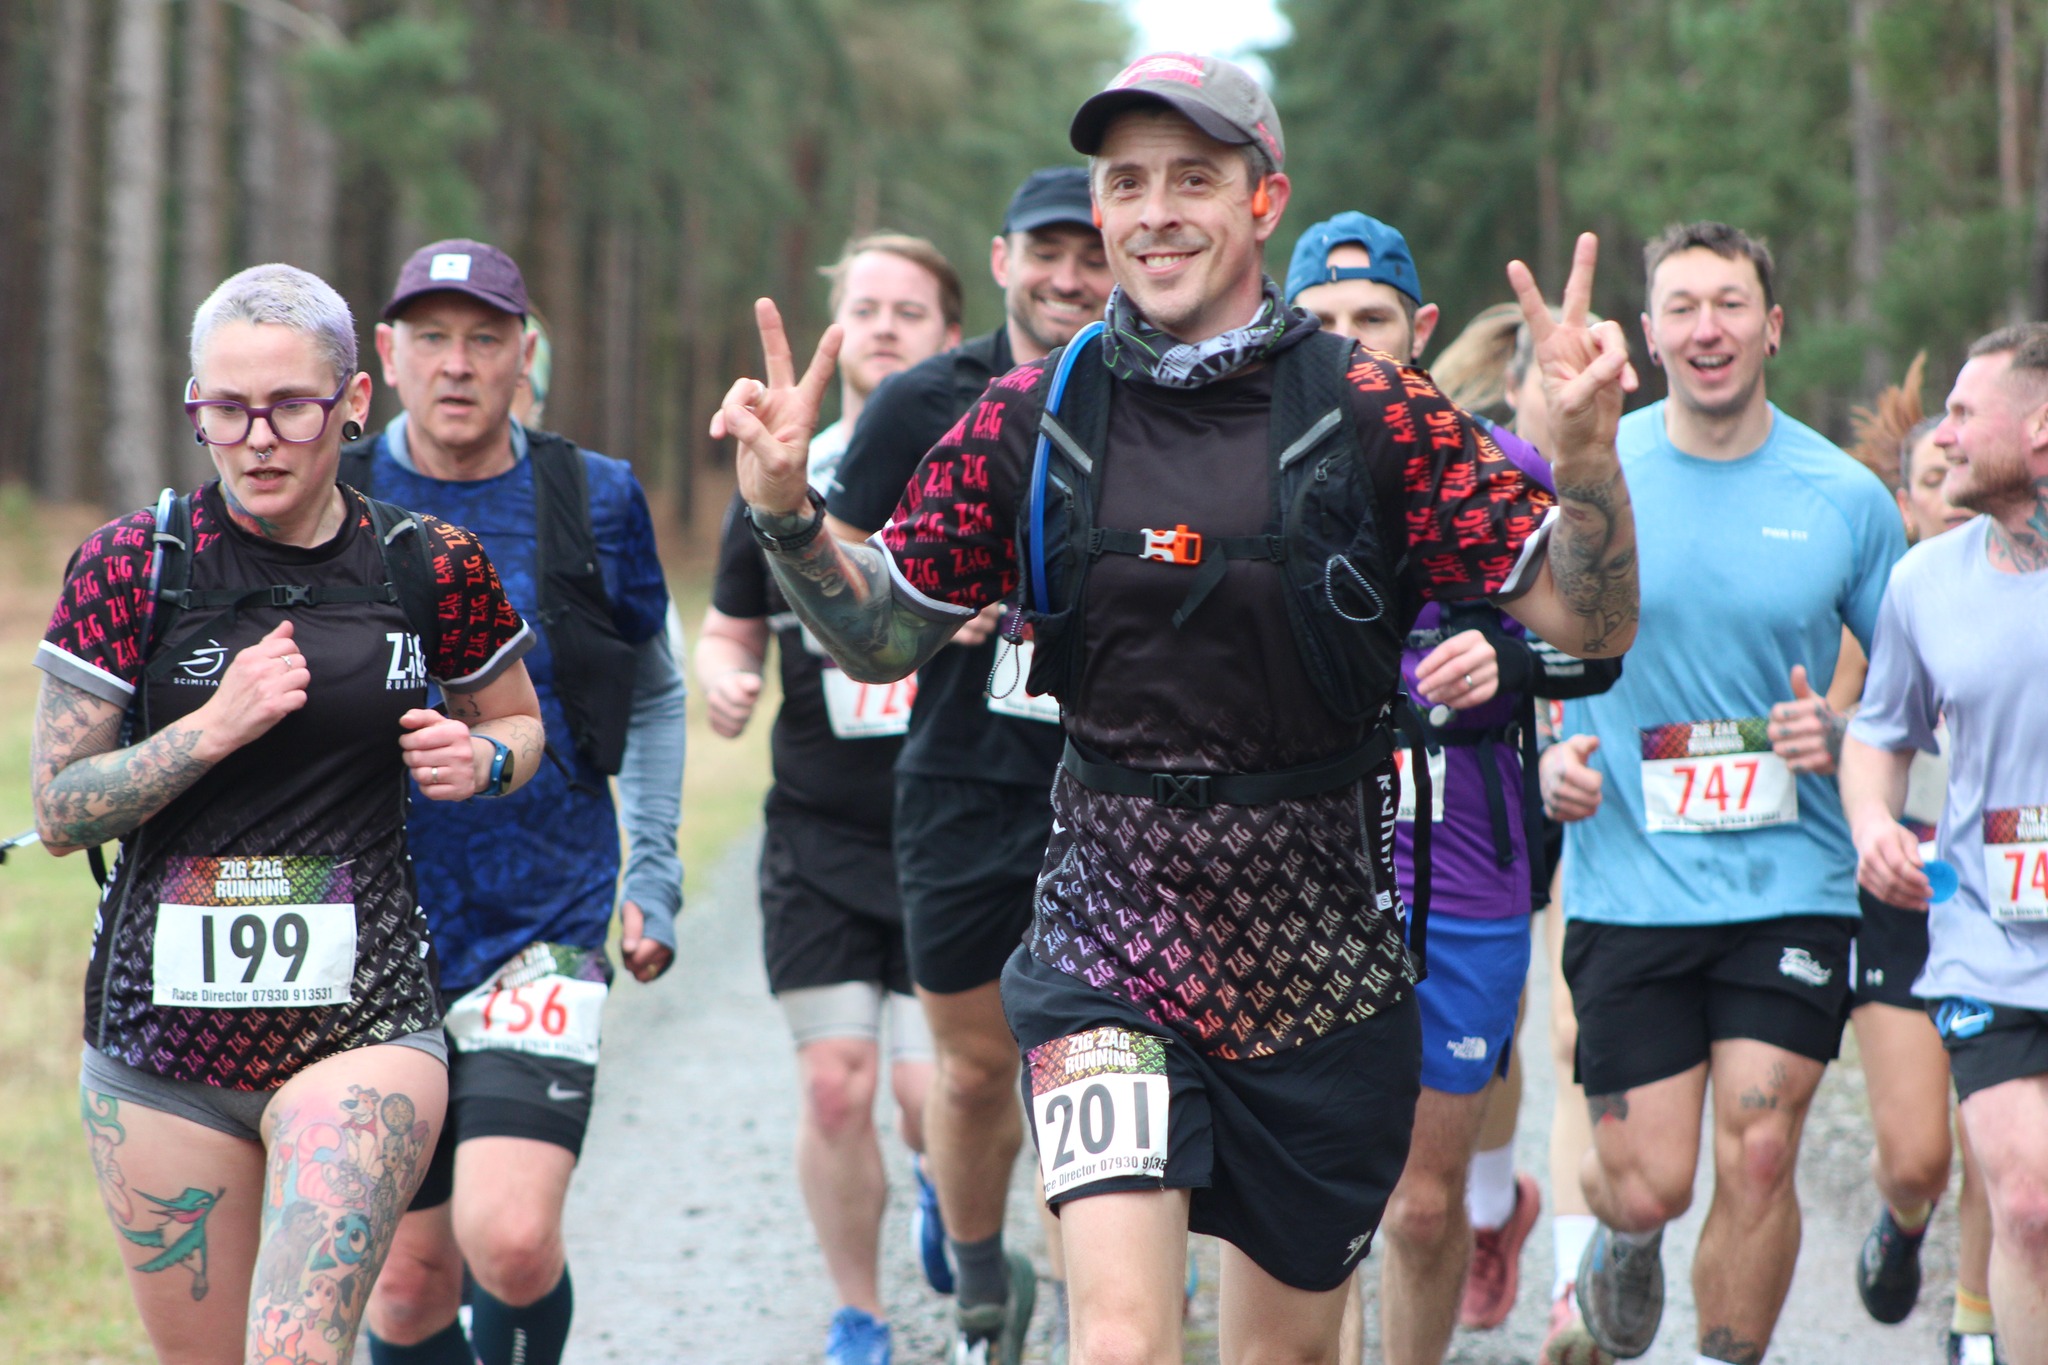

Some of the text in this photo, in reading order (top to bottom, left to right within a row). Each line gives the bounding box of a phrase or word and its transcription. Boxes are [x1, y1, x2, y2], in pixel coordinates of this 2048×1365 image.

[1673, 760, 1759, 816] 747
[219, 860, 283, 879] ZIG ZAG
[215, 879, 291, 898] RUNNING
[202, 912, 309, 983] 199
[172, 987, 333, 1001] Race Director 07930 913531
[1069, 1030, 1130, 1054] ZIG ZAG
[1065, 1049, 1137, 1074] RUNNING
[1045, 1083, 1150, 1171] 201
[1059, 1163, 1096, 1185] Director
[1101, 1156, 1138, 1171] 07930
